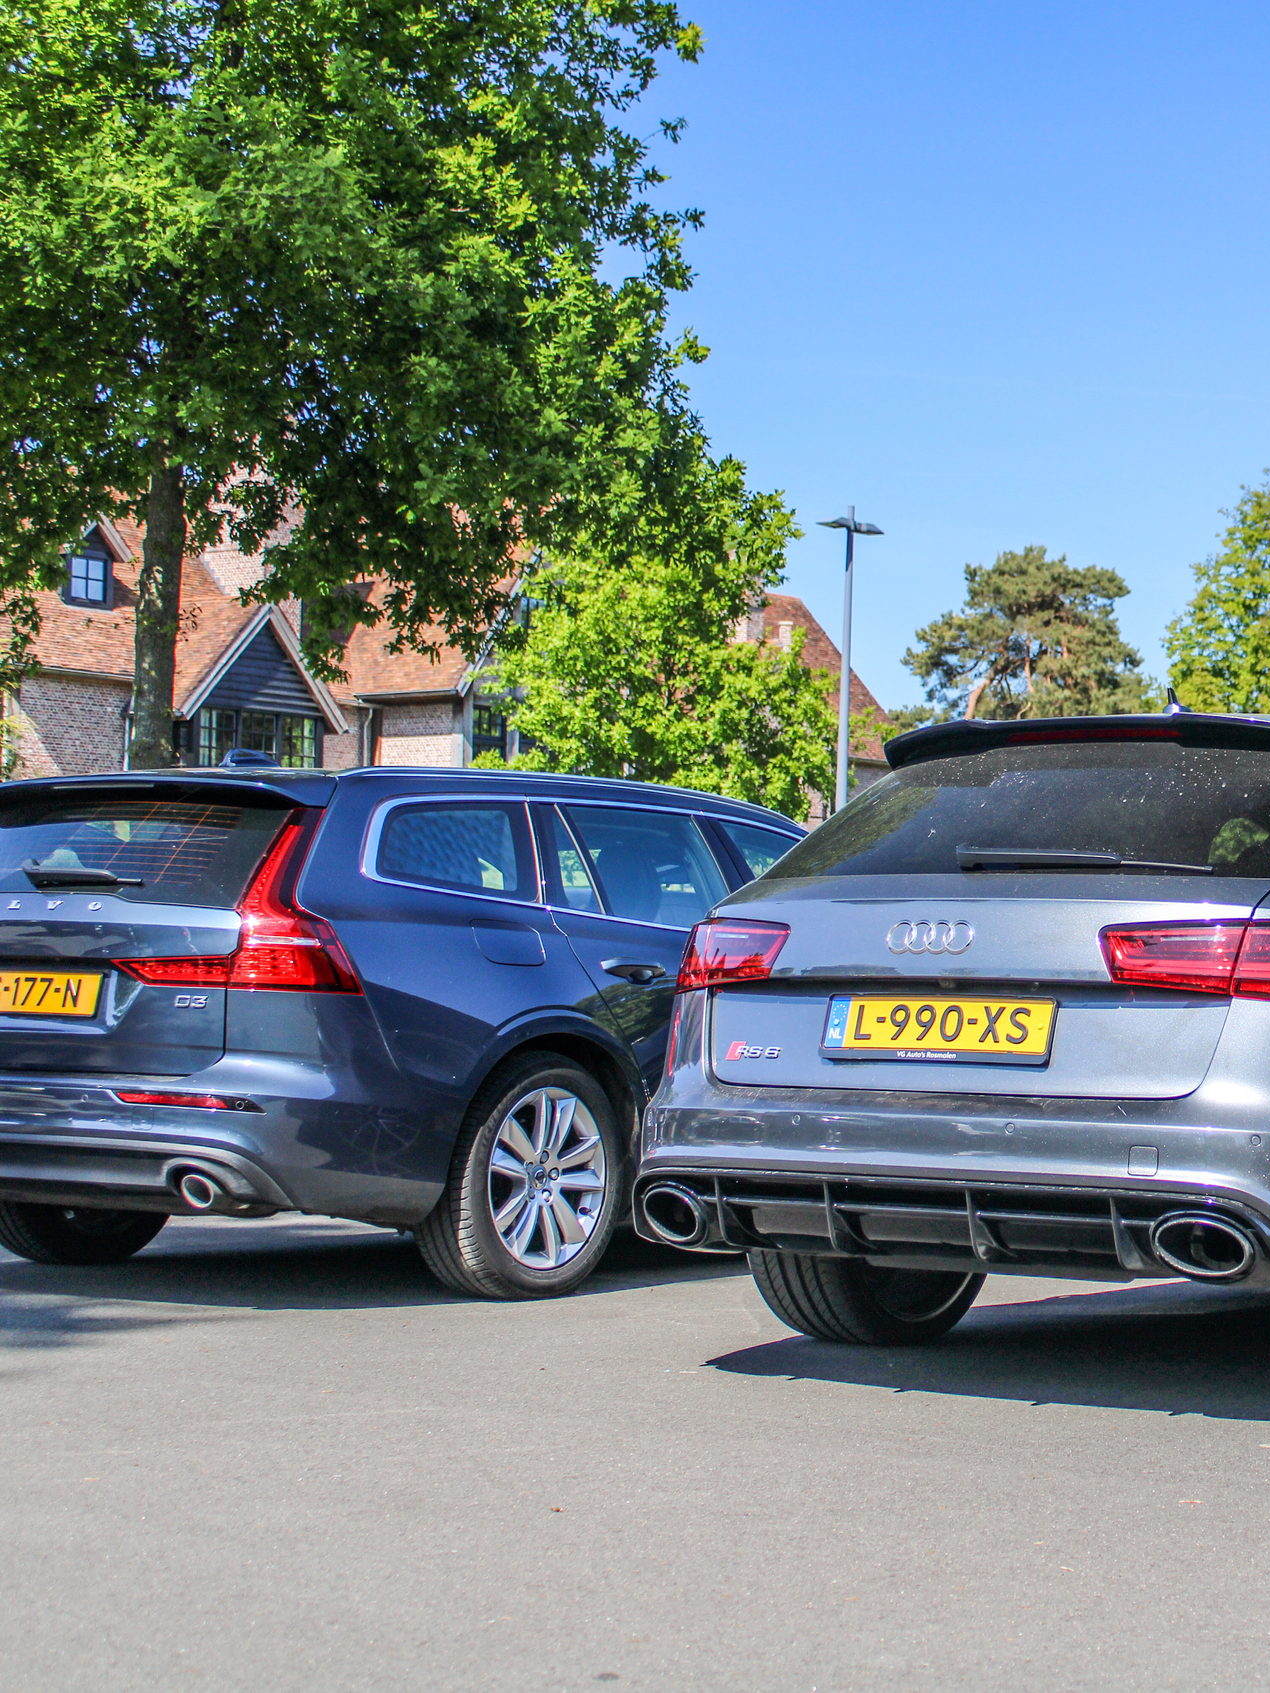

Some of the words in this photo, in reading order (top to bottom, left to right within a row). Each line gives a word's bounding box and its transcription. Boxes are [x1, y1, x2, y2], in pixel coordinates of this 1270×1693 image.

[0, 977, 82, 1007] -177-N
[174, 995, 209, 1009] D3
[854, 1004, 1032, 1044] L-990-XS
[828, 1028, 842, 1039] NL
[926, 1051, 957, 1059] Rosmalen
